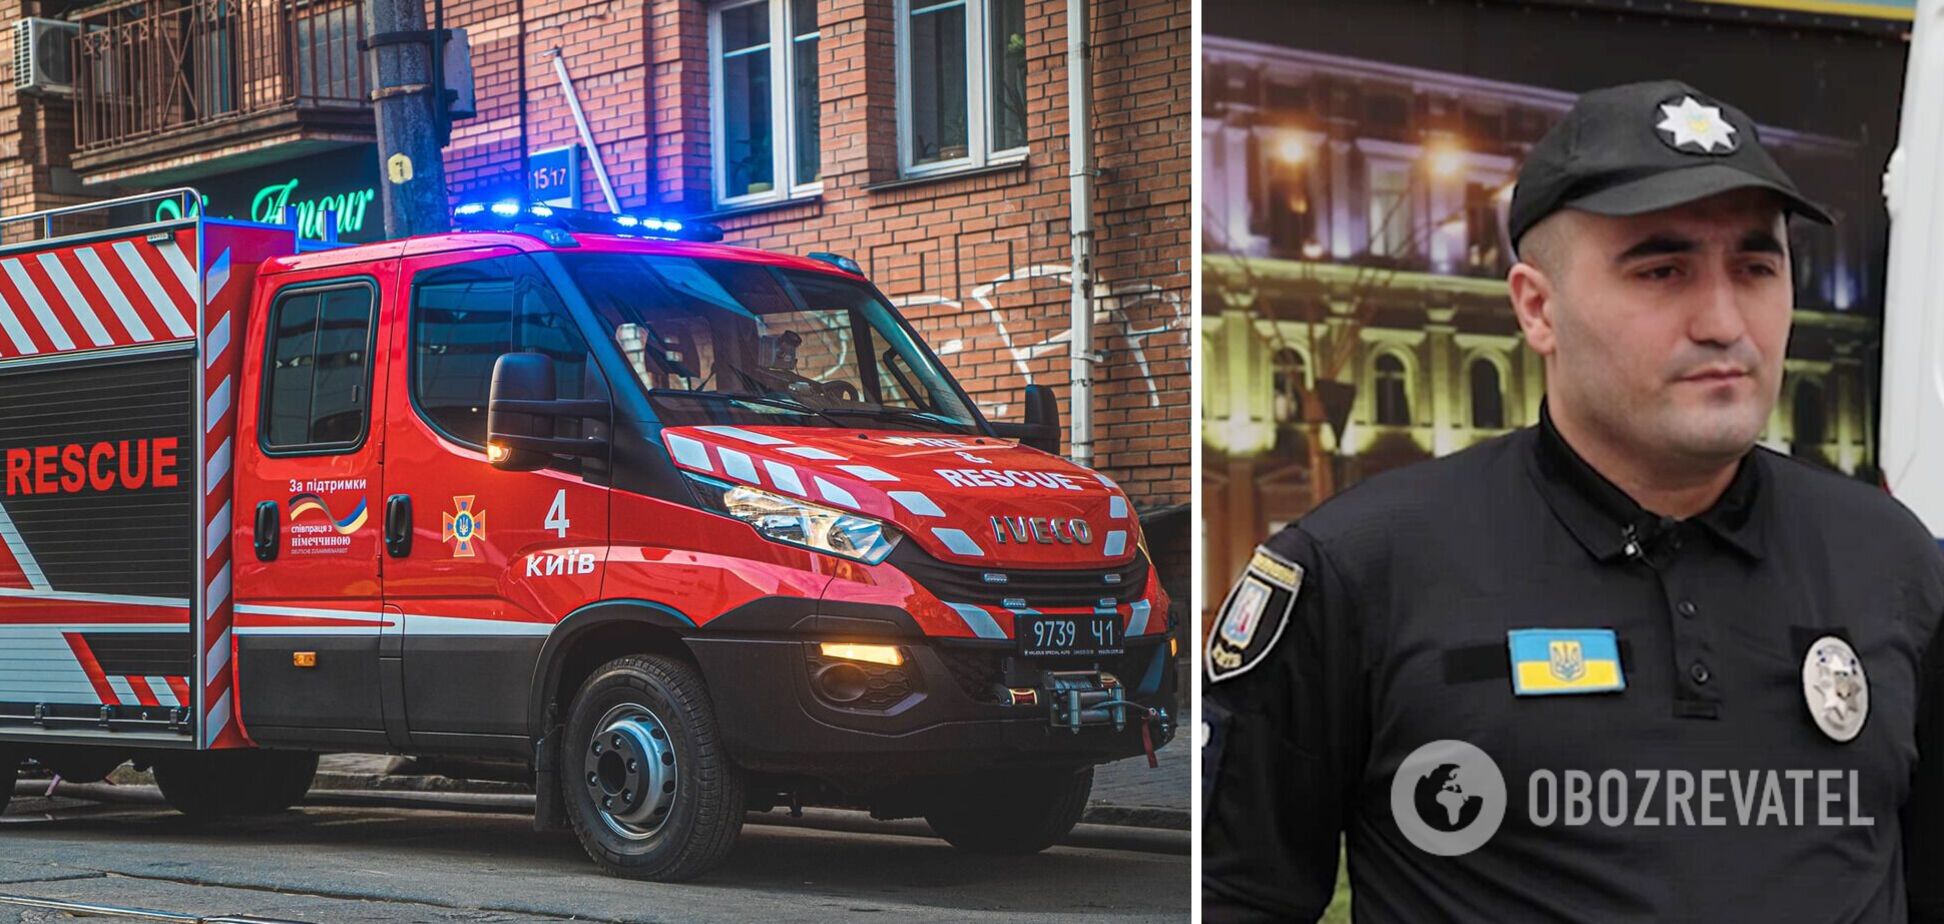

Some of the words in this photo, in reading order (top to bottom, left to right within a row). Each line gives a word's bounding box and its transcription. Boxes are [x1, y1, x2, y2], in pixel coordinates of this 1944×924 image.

[6, 436, 178, 496] RESCUE
[954, 451, 992, 464] &
[289, 479, 303, 492] За
[306, 478, 367, 493] підтримки
[933, 468, 1084, 491] RESCUE
[544, 489, 570, 538] 4
[291, 534, 351, 547] німеччиною
[990, 515, 1093, 544] IVECO
[1034, 620, 1076, 647] 9739
